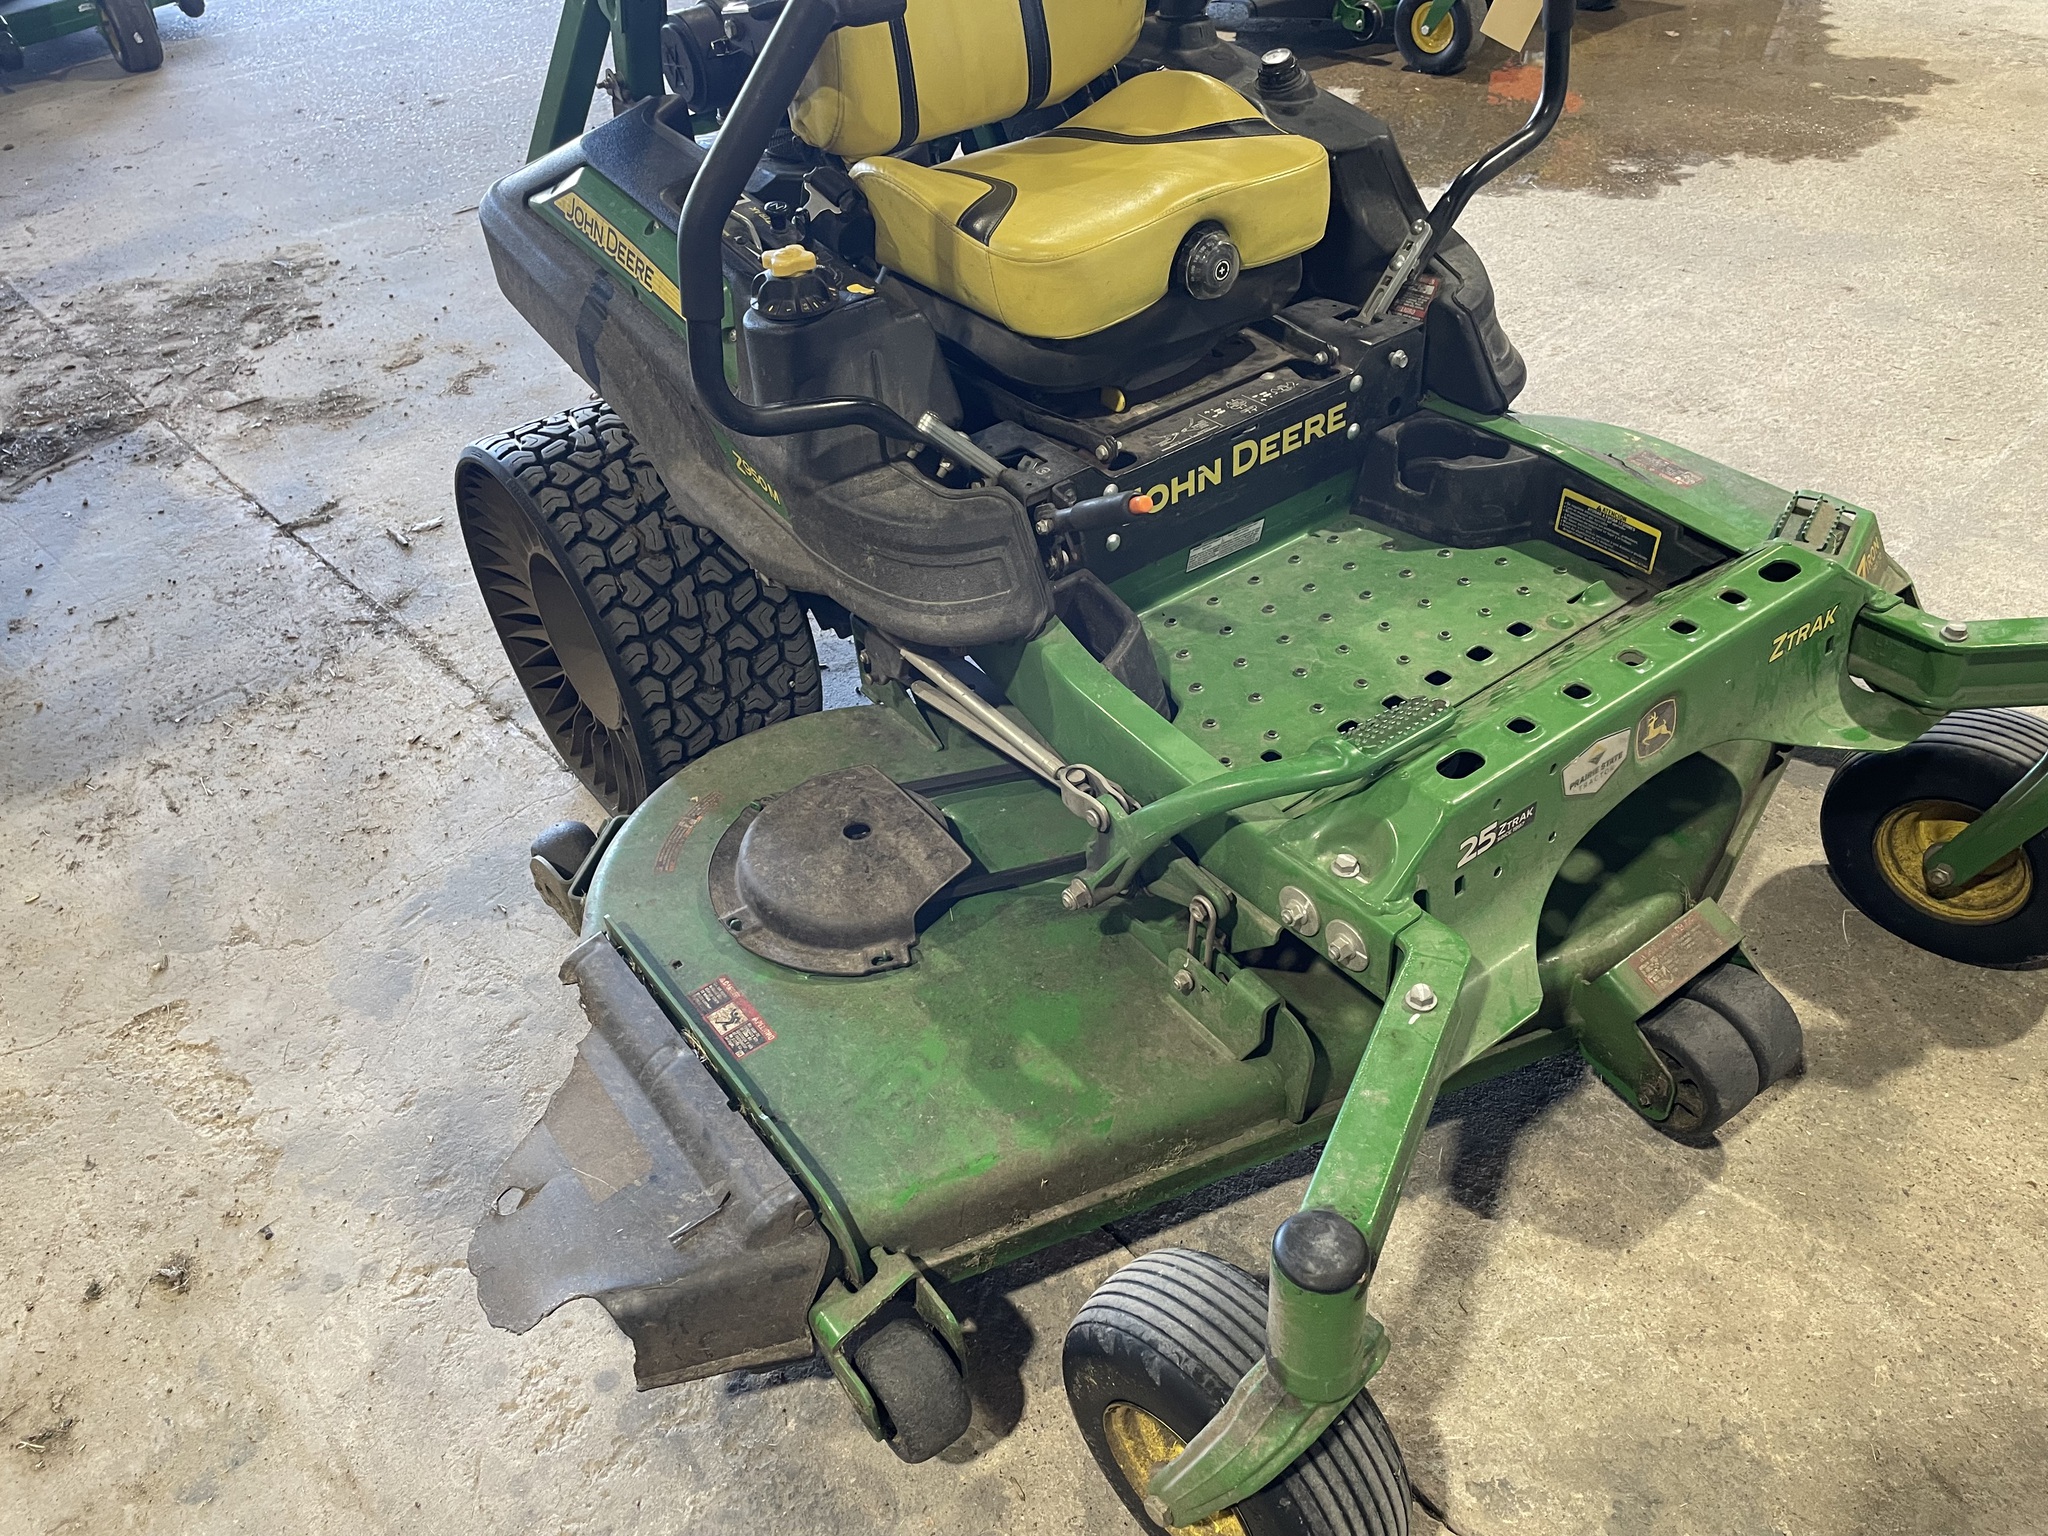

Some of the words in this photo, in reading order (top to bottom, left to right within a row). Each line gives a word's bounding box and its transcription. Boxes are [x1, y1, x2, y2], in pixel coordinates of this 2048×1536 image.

[566, 198, 604, 246] JOHN
[606, 227, 655, 291] DEERE
[732, 450, 781, 505] Z950M
[1134, 457, 1222, 514] OHN
[1232, 402, 1348, 478] DEERE
[1769, 603, 1841, 663] ZTRAK
[1569, 766, 1600, 791] PRAIRIE
[1600, 751, 1624, 771] STATE
[1578, 764, 1615, 791] TRACTOR
[1457, 821, 1498, 869] 25
[1497, 806, 1535, 837] ZTRAK
